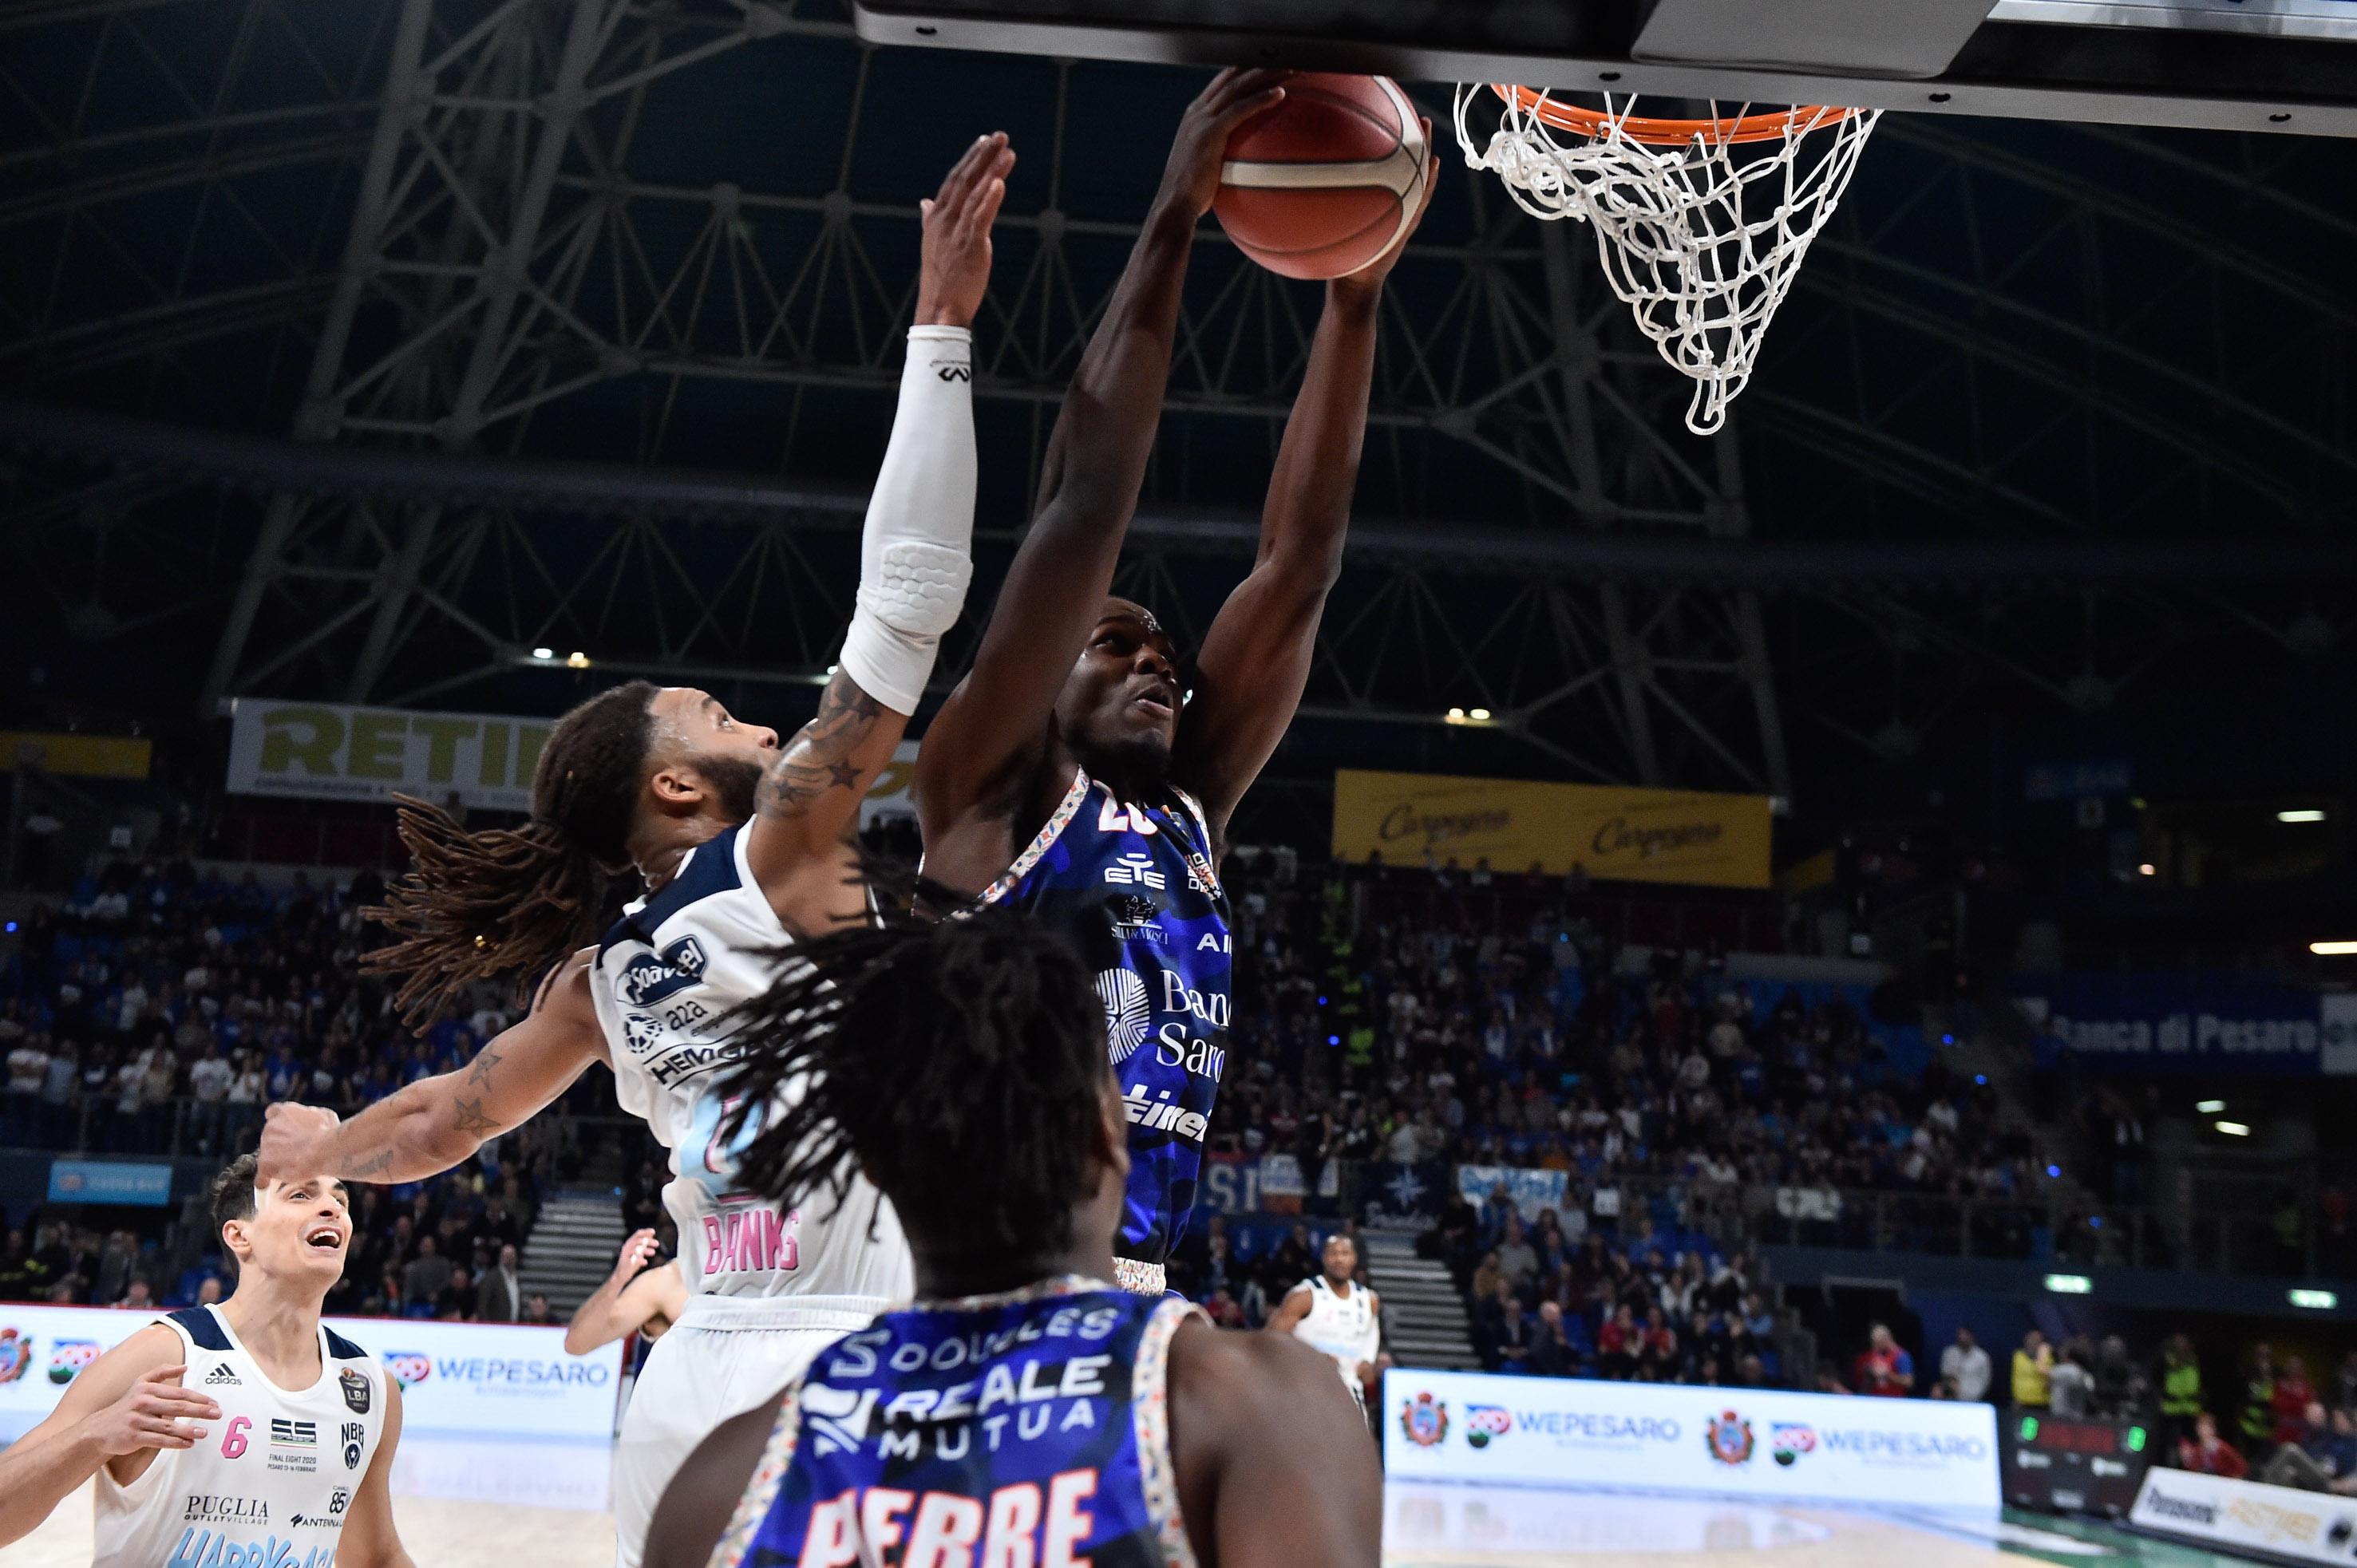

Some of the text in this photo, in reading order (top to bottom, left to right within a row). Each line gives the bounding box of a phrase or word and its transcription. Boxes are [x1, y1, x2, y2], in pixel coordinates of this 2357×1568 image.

[1196, 933, 1232, 955] AI
[1160, 970, 1232, 1027] Ban
[666, 1001, 708, 1030] a2a
[702, 1209, 798, 1275] BANKS
[205, 1375, 243, 1385] adidas
[438, 1357, 608, 1387] WEPESARO
[884, 1354, 1112, 1424] REALE
[220, 1416, 252, 1459] 6
[341, 1422, 365, 1452] NBB
[877, 1397, 1095, 1462] MUTUA
[1517, 1412, 1682, 1442] WEPESARO
[1822, 1431, 1986, 1461] WEPESARO
[186, 1496, 269, 1517] PUGLIA
